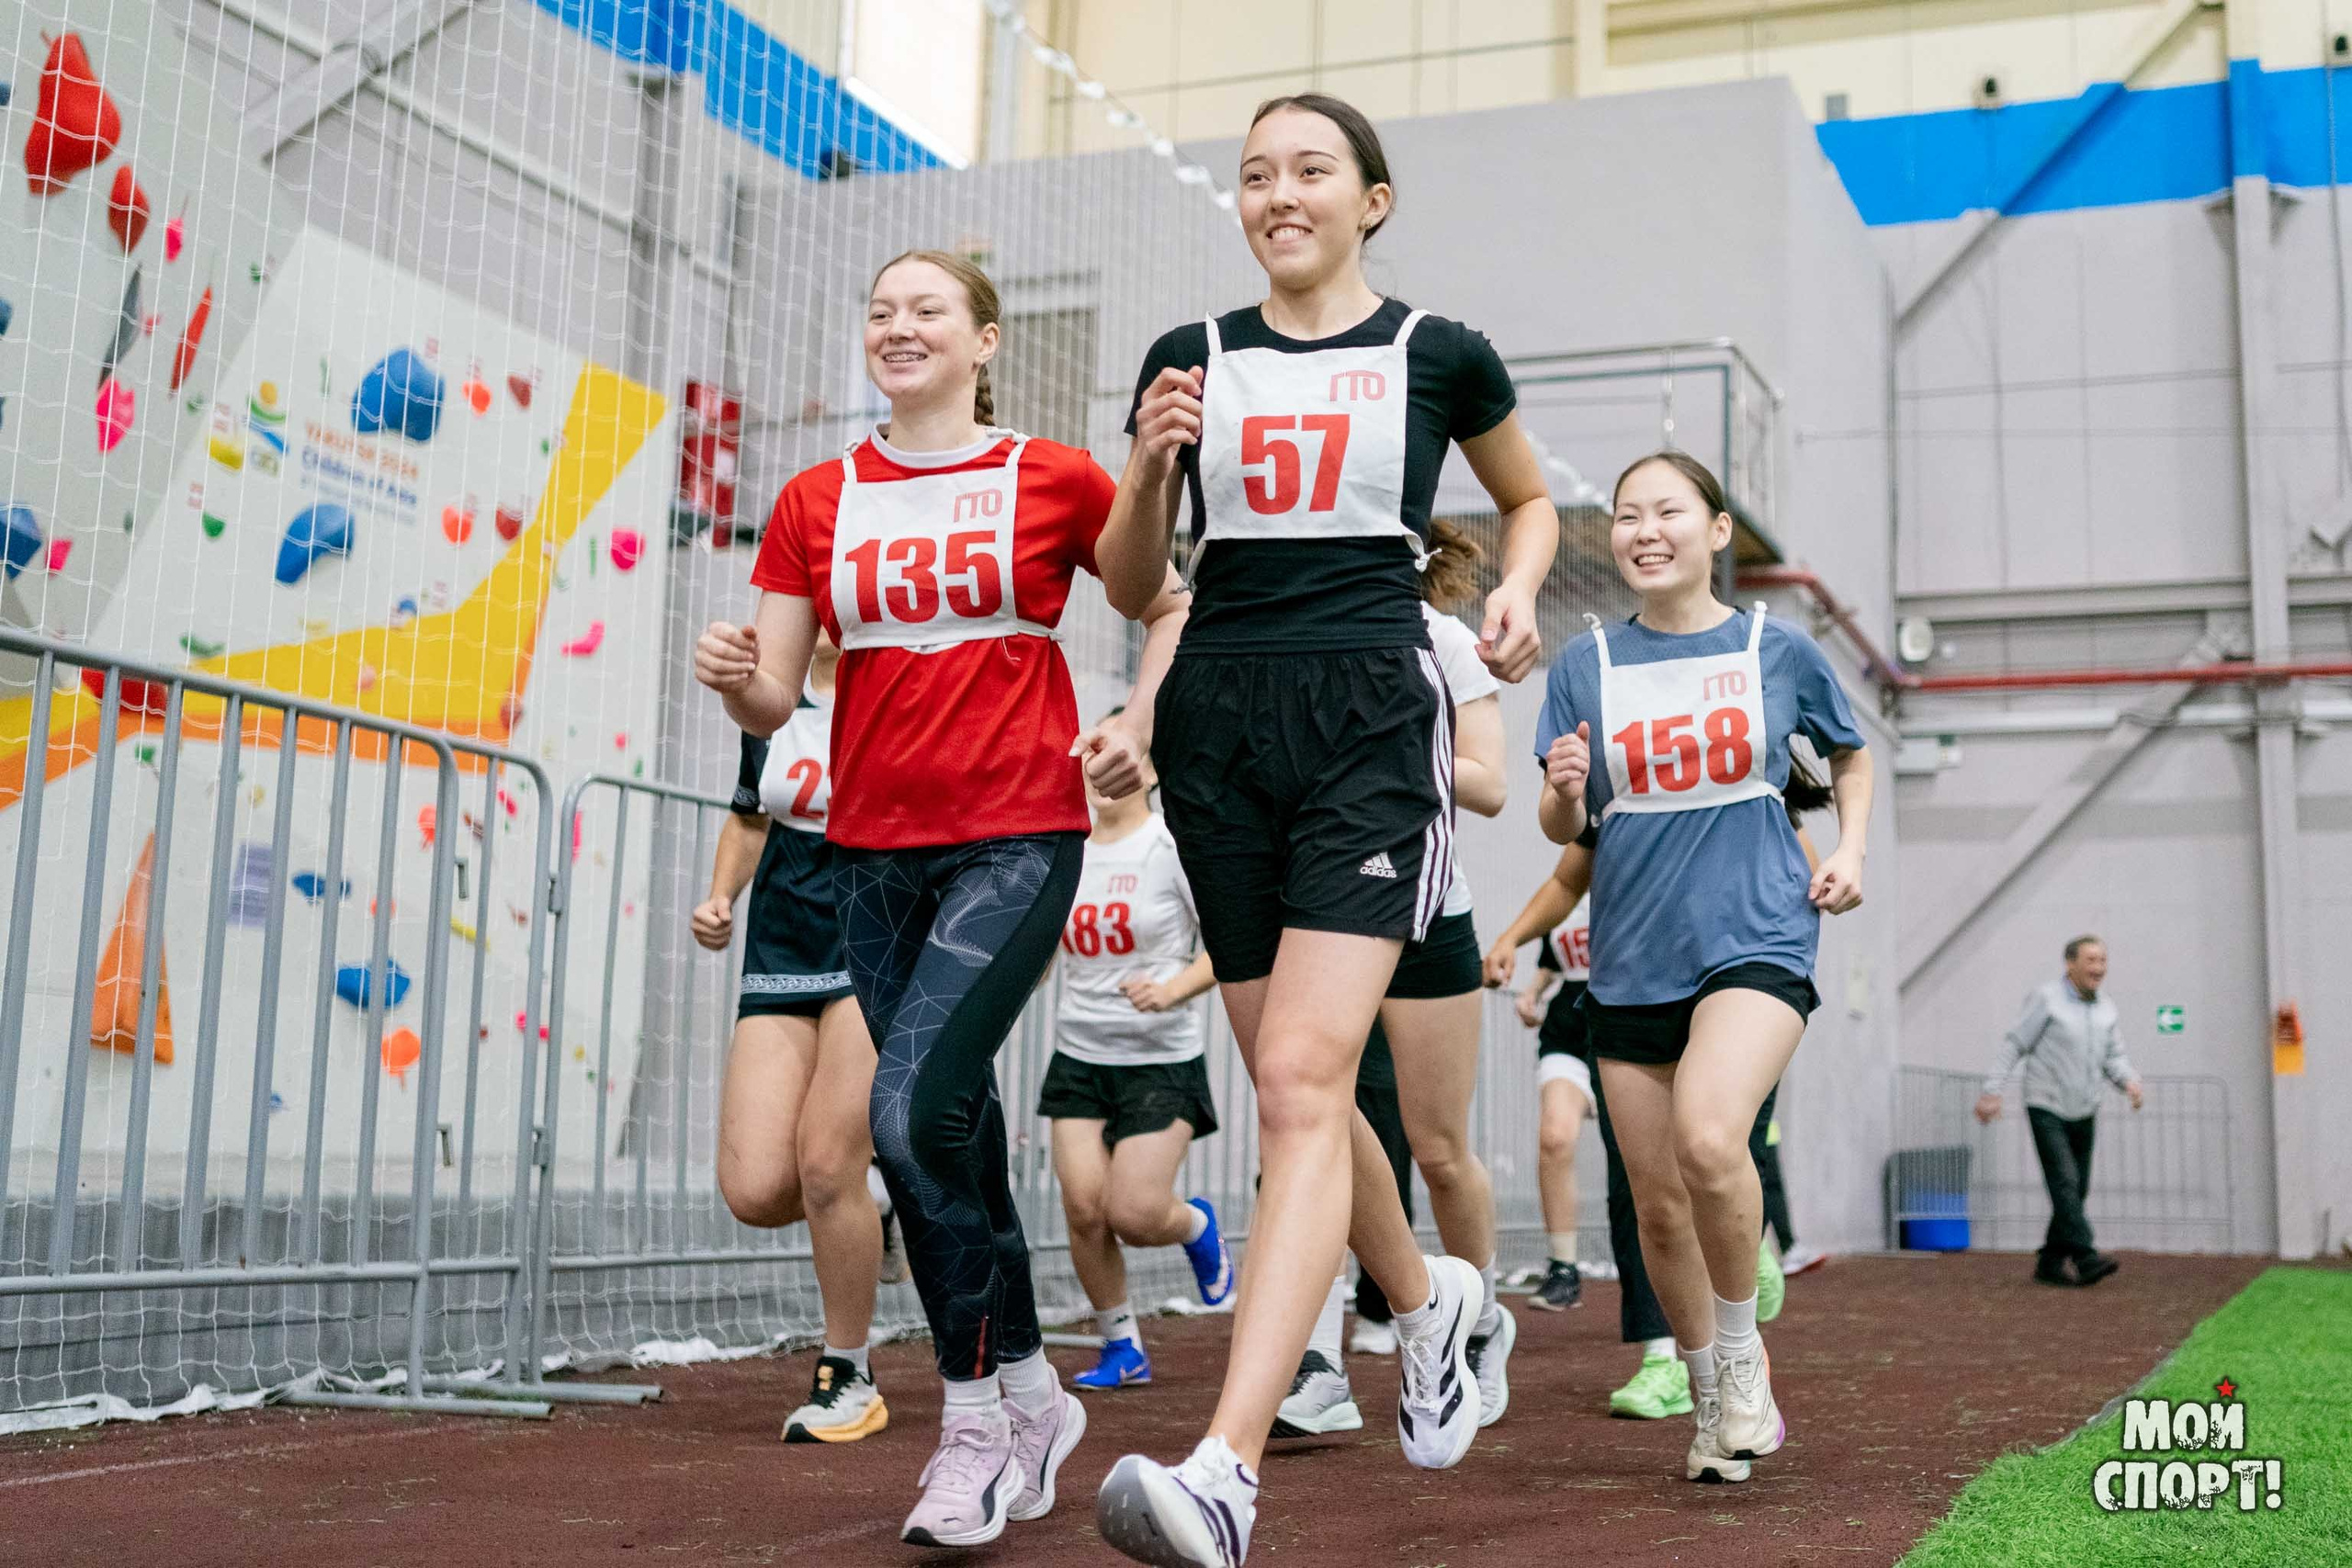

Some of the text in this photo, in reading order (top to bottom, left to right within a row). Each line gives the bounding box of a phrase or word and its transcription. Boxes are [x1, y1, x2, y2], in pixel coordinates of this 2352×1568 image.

[1329, 370, 1385, 401] ГТО
[1241, 414, 1351, 515] 57
[954, 489, 1003, 523] ГТО
[845, 530, 1003, 624] 135
[1703, 671, 1747, 701] ГТО
[1612, 707, 1753, 795] 158
[786, 758, 832, 819] 2
[1360, 865, 1396, 878] adidas
